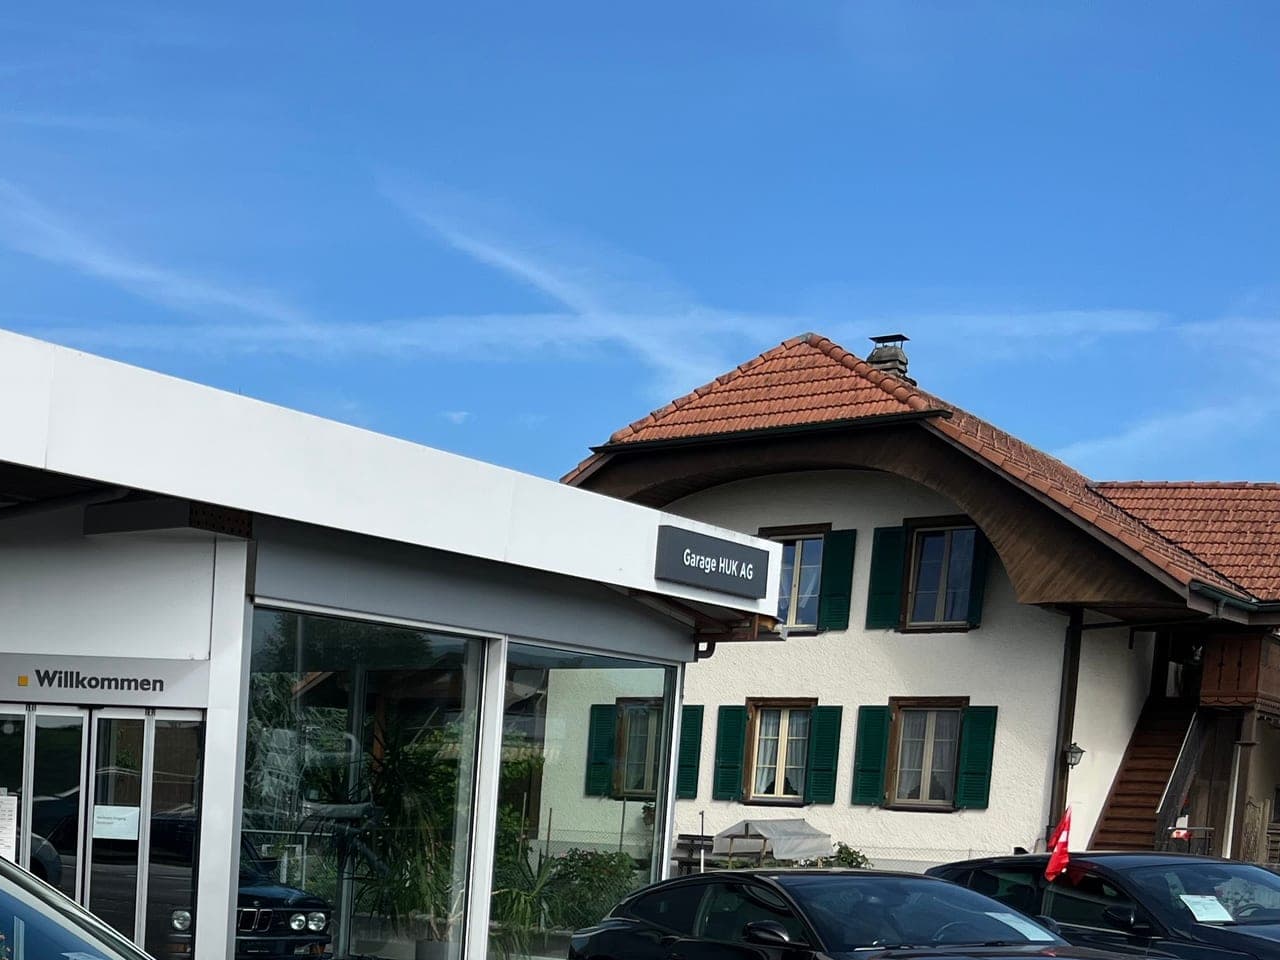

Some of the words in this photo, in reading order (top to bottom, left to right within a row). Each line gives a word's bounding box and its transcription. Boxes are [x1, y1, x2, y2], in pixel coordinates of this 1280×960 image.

[683, 548, 717, 573] Garage
[718, 556, 738, 577] HUK
[739, 562, 753, 580] AG
[34, 669, 165, 692] Willkommen
